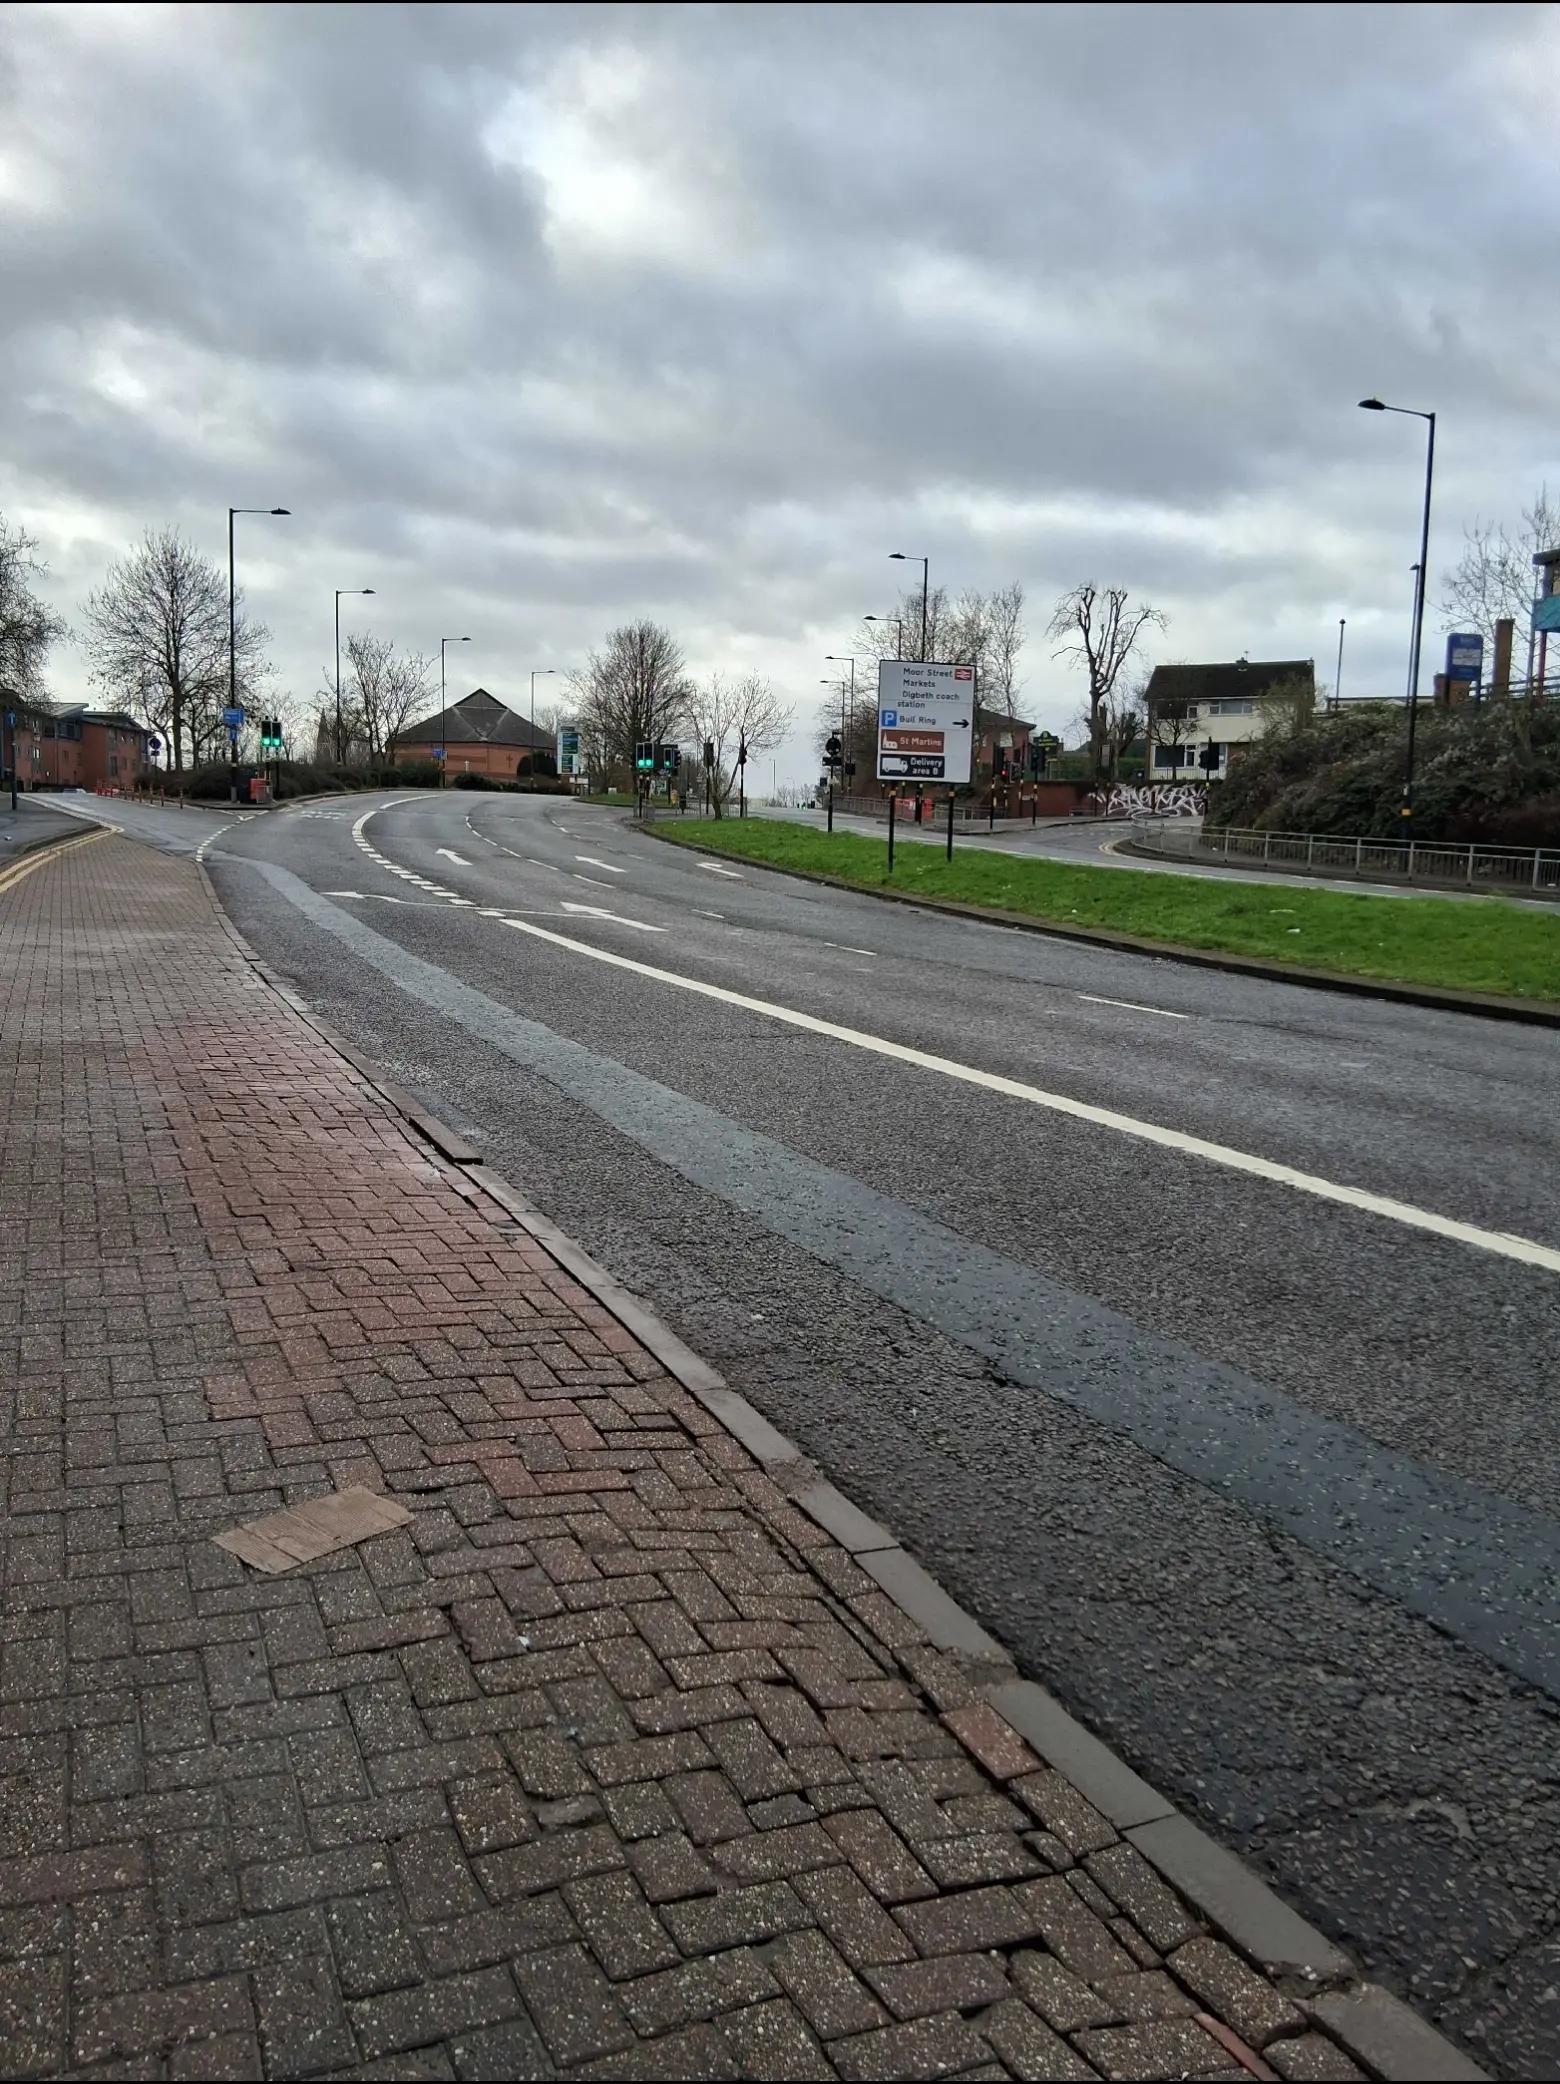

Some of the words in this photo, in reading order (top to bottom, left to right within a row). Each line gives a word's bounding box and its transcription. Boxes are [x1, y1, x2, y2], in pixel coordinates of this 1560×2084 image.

[903, 667, 924, 676] Moor
[927, 669, 953, 678] Street
[903, 679, 936, 688] Markets
[902, 690, 934, 700] Digbeth
[936, 692, 960, 700] coach
[897, 700, 926, 709] station
[885, 712, 894, 726] P
[899, 715, 916, 724] Bull
[918, 716, 936, 726] Ring
[900, 736, 909, 745] St
[911, 738, 942, 746] Martins
[910, 757, 943, 768] Delivery
